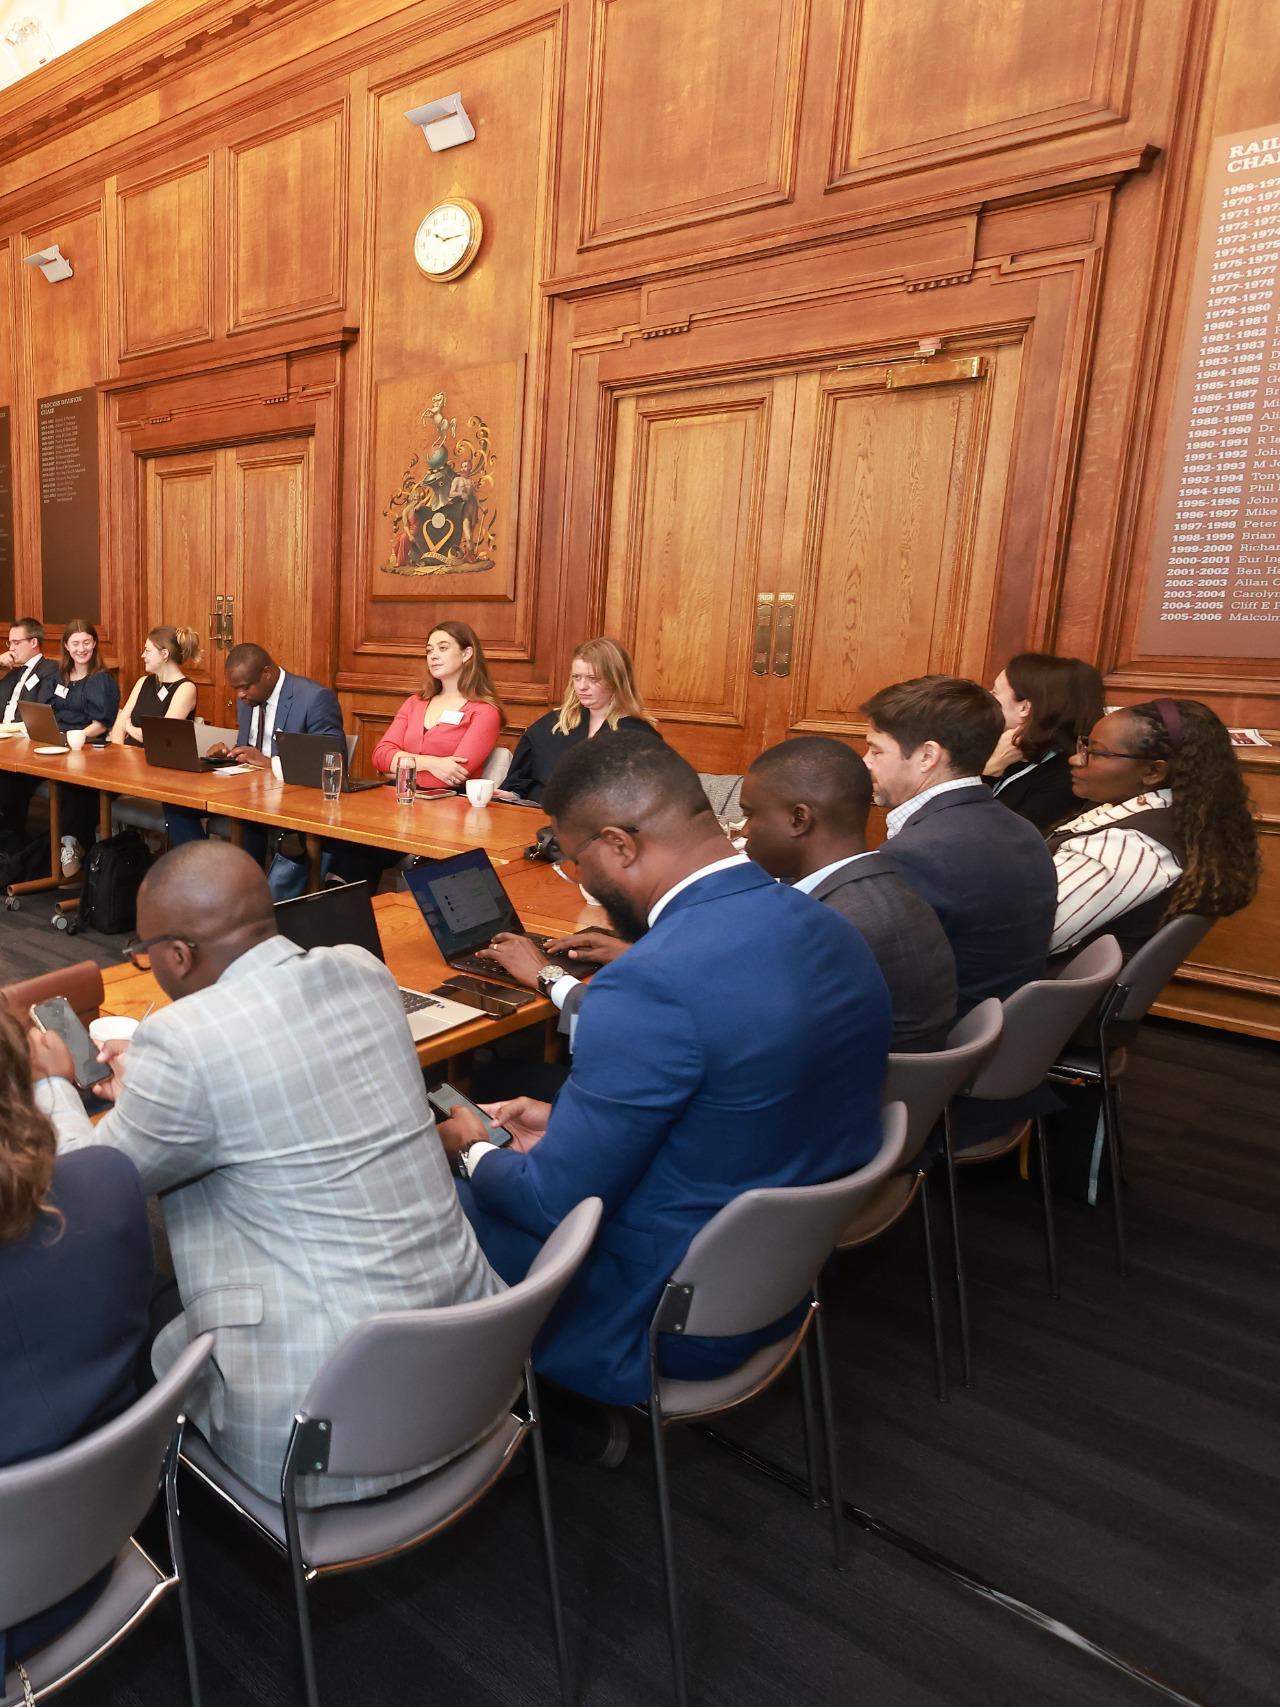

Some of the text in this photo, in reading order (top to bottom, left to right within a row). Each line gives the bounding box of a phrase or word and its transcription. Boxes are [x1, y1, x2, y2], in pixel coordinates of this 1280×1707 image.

[1220, 203, 1280, 220] 1971-197
[1210, 265, 1277, 282] 1976-1977
[1207, 291, 1273, 307] 1978-1979
[1205, 303, 1271, 319] 1979-1980
[1203, 316, 1268, 331] 1980-1981
[1201, 328, 1267, 343] 1981-1982
[1198, 353, 1263, 367] 1983-1984
[1196, 365, 1261, 380] 1984-1985
[1193, 389, 1257, 403] 1986-1987
[1191, 402, 1255, 415] 1987-1988
[1190, 414, 1253, 427] 1988-1989
[1188, 424, 1274, 438] 1989-1990 Dr
[1186, 438, 1248, 450] 1990-1991
[1257, 436, 1266, 444] R
[1184, 450, 1247, 461] 1991-1992
[1182, 462, 1246, 473] 1992-1993
[1253, 460, 1266, 469] M
[1181, 474, 1244, 485] 1993-1994
[1179, 484, 1274, 497] 1994-1995 Phil
[1177, 496, 1278, 507] 1995-1996 John
[1175, 508, 1278, 519] 1996-1997 Mike
[1174, 520, 1277, 530] 1997-1998 Peter
[1172, 532, 1276, 542] 1998-1999 Brian
[1170, 544, 1233, 553] 1999-2000
[1168, 556, 1231, 564] 2000-2001
[1238, 555, 1261, 564] Eur
[1166, 567, 1229, 576] 2001-2002
[1236, 567, 1261, 575] Ben
[1165, 579, 1227, 587] 2002-2003
[1163, 590, 1226, 598] 2003-2004
[1162, 602, 1224, 610] 2004-2005
[1231, 602, 1257, 610] Cliff
[1261, 602, 1271, 610] E
[1160, 613, 1222, 621] 2005-2006
